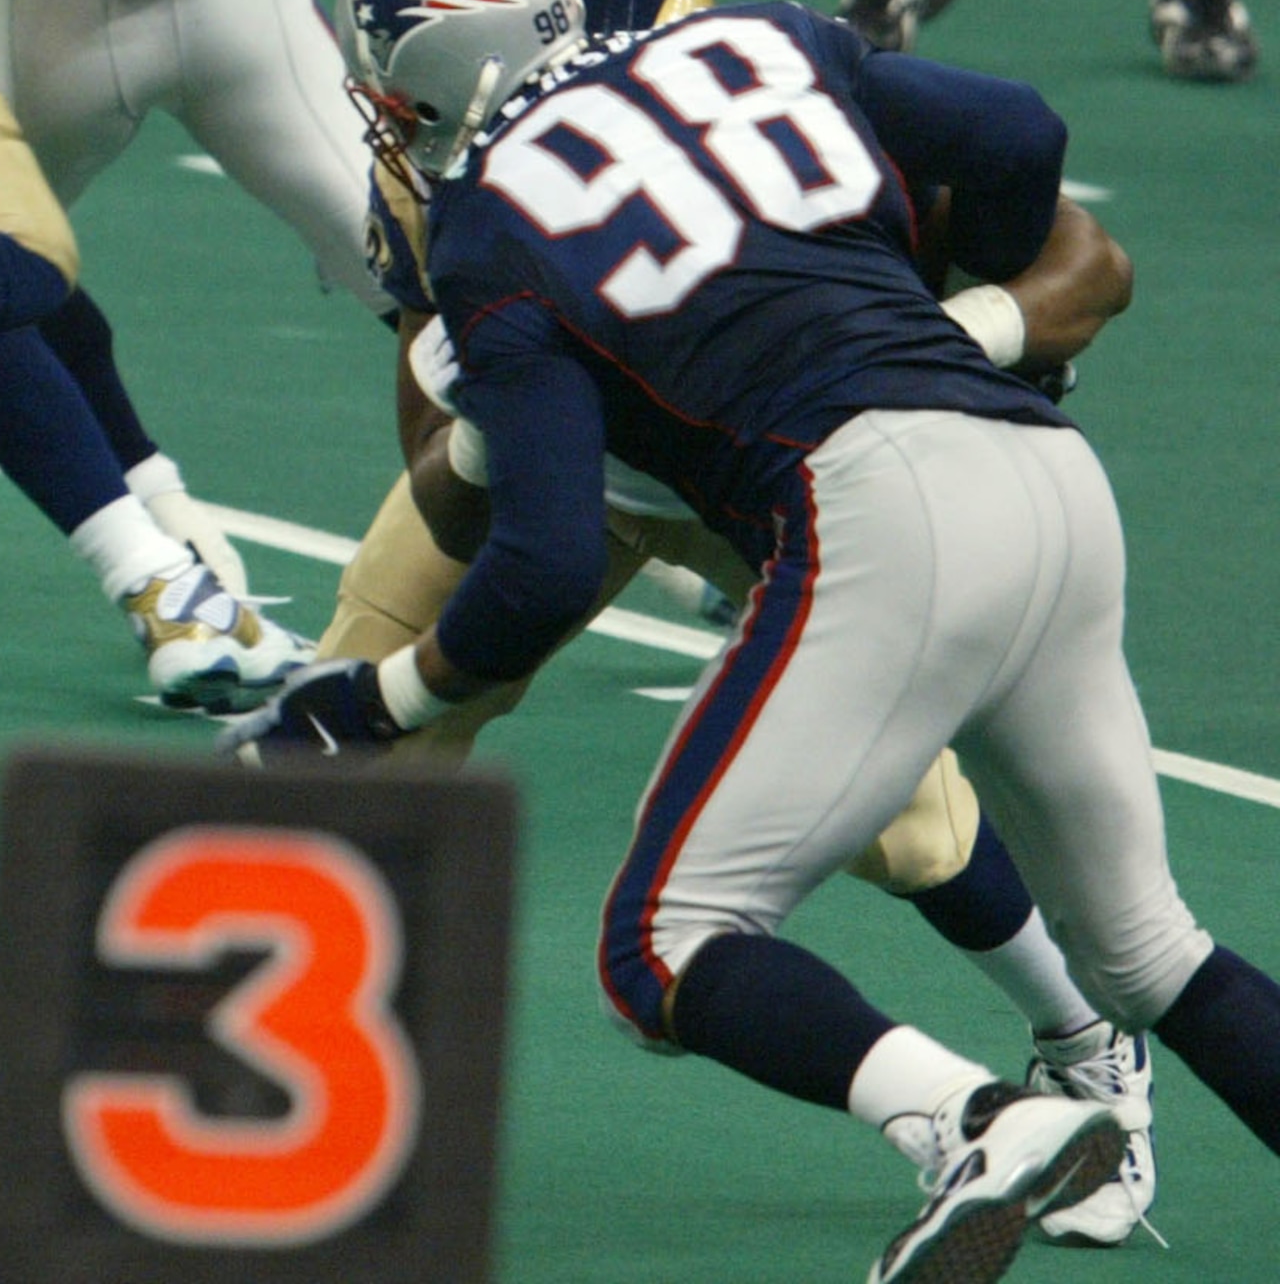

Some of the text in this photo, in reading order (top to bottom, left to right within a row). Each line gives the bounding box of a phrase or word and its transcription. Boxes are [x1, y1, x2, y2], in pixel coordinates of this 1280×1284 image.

[479, 14, 883, 320] 98
[533, 0, 569, 45] 98
[64, 826, 419, 1246] 3
